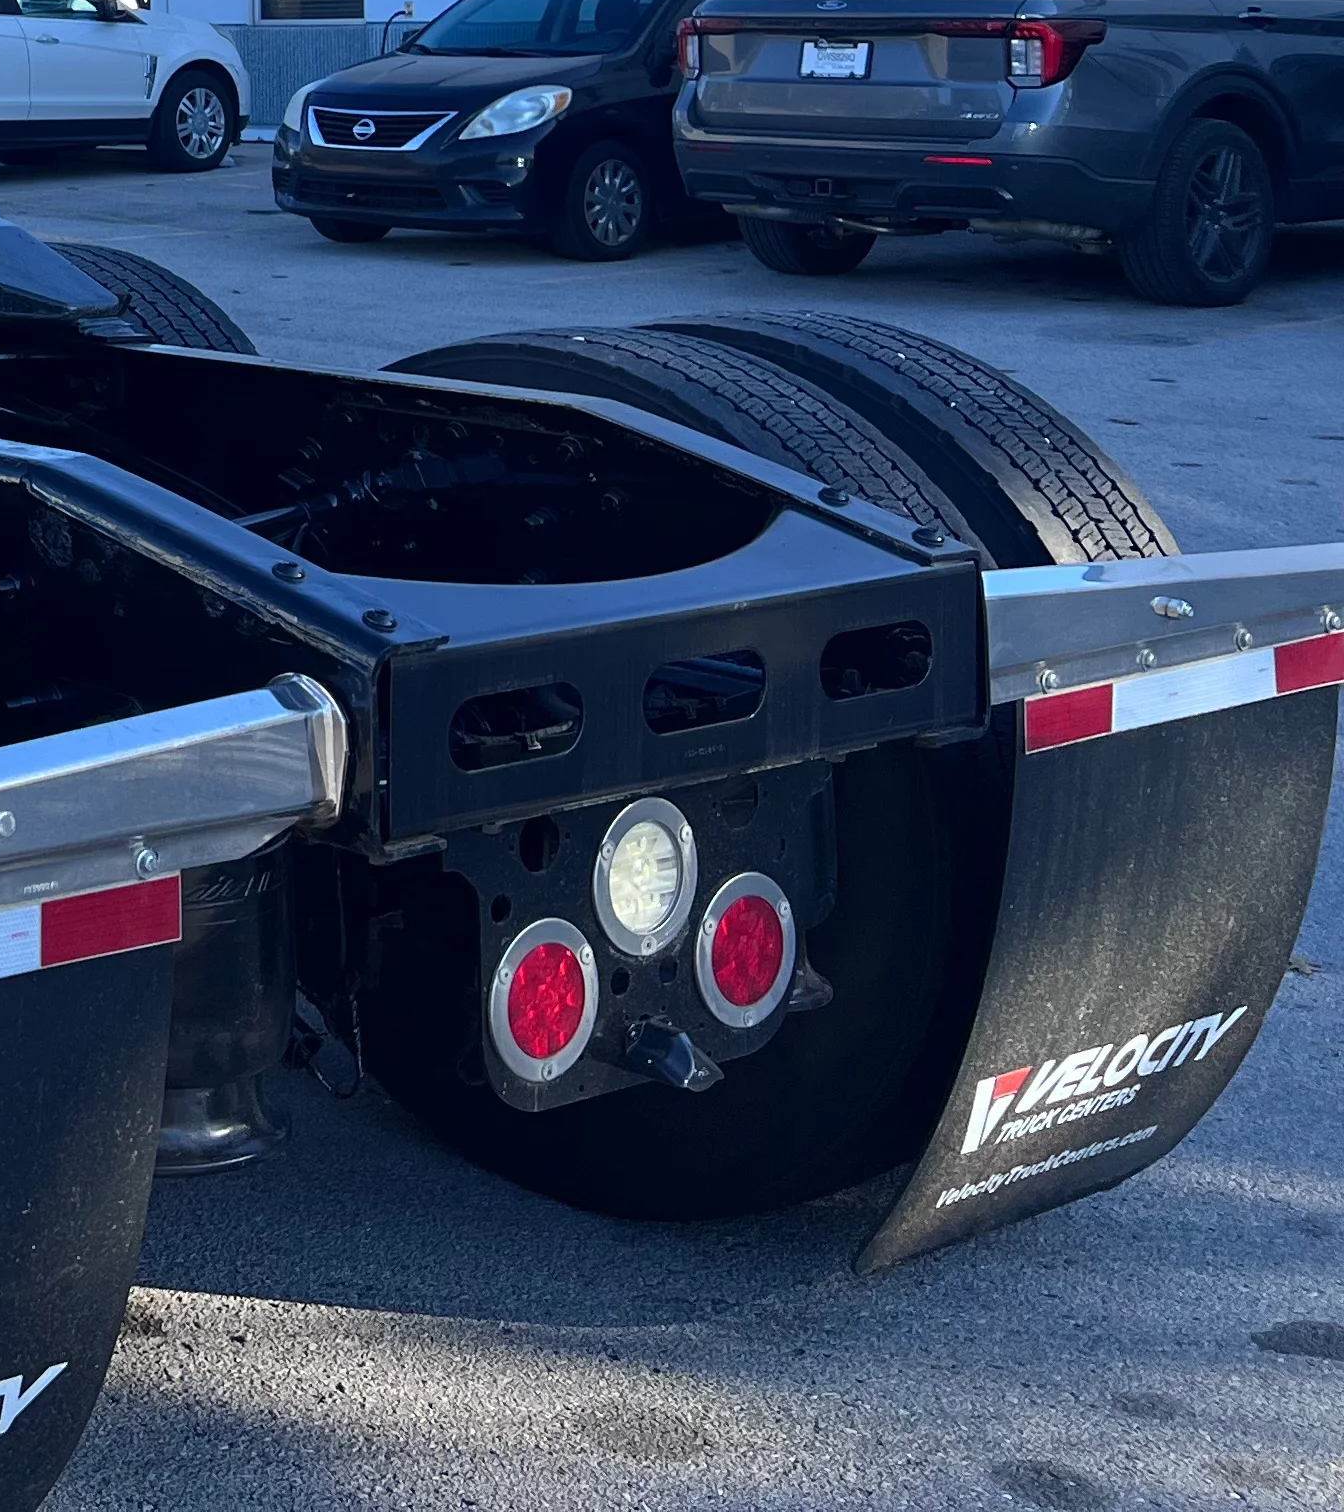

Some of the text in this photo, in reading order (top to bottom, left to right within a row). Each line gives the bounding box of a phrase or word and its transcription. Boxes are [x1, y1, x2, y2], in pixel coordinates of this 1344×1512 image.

[1015, 1005, 1247, 1113] VELOCITY
[994, 1083, 1142, 1145] TRUCK CENTERS
[935, 1124, 1158, 1210] VelocityTruckCenters.com
